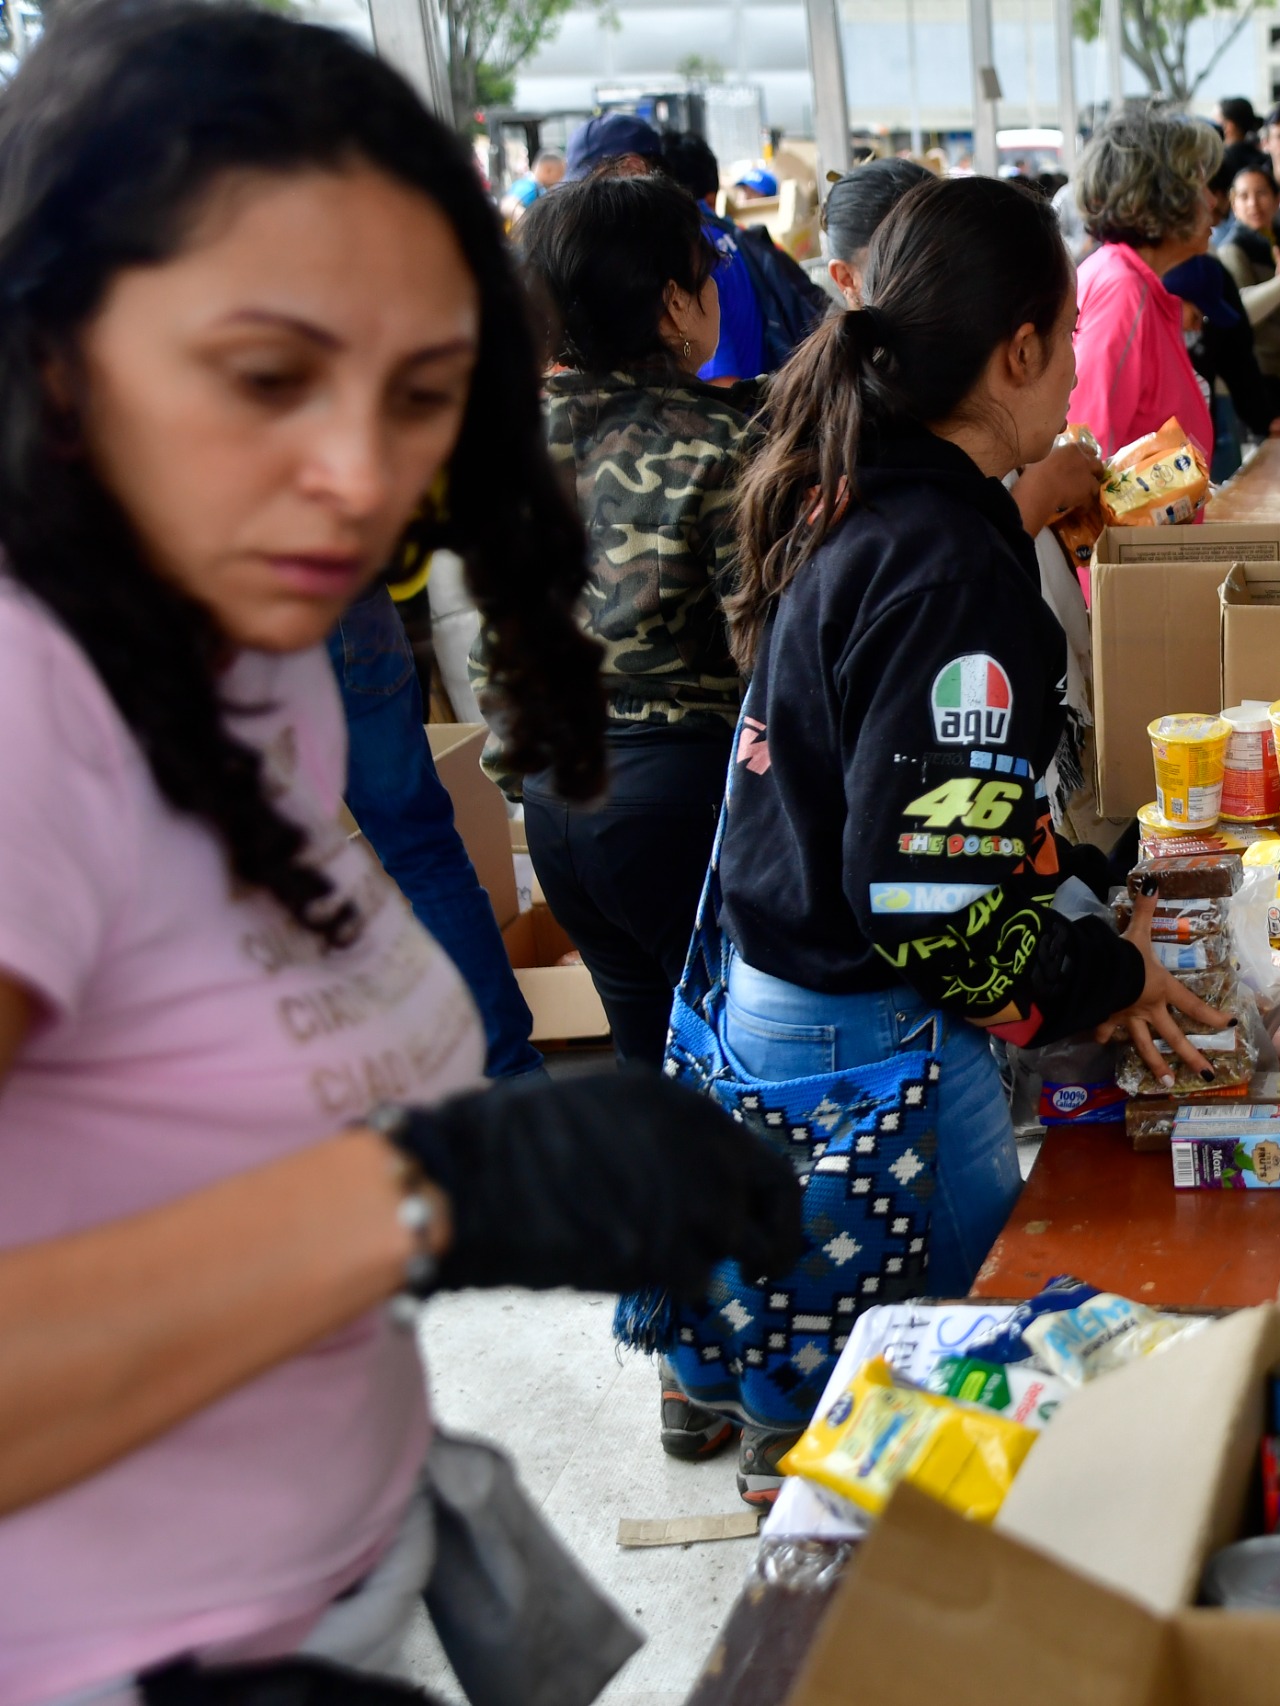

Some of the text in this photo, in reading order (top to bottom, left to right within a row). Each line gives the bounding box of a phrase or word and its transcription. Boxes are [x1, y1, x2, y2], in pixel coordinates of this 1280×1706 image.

[938, 707, 1010, 745] agv
[902, 777, 1023, 830] 46
[898, 832, 1026, 858] THE DOCTOR
[1055, 1099, 1082, 1109] Calidad
[1058, 1090, 1086, 1101] 100%
[1211, 1149, 1223, 1179] Mora
